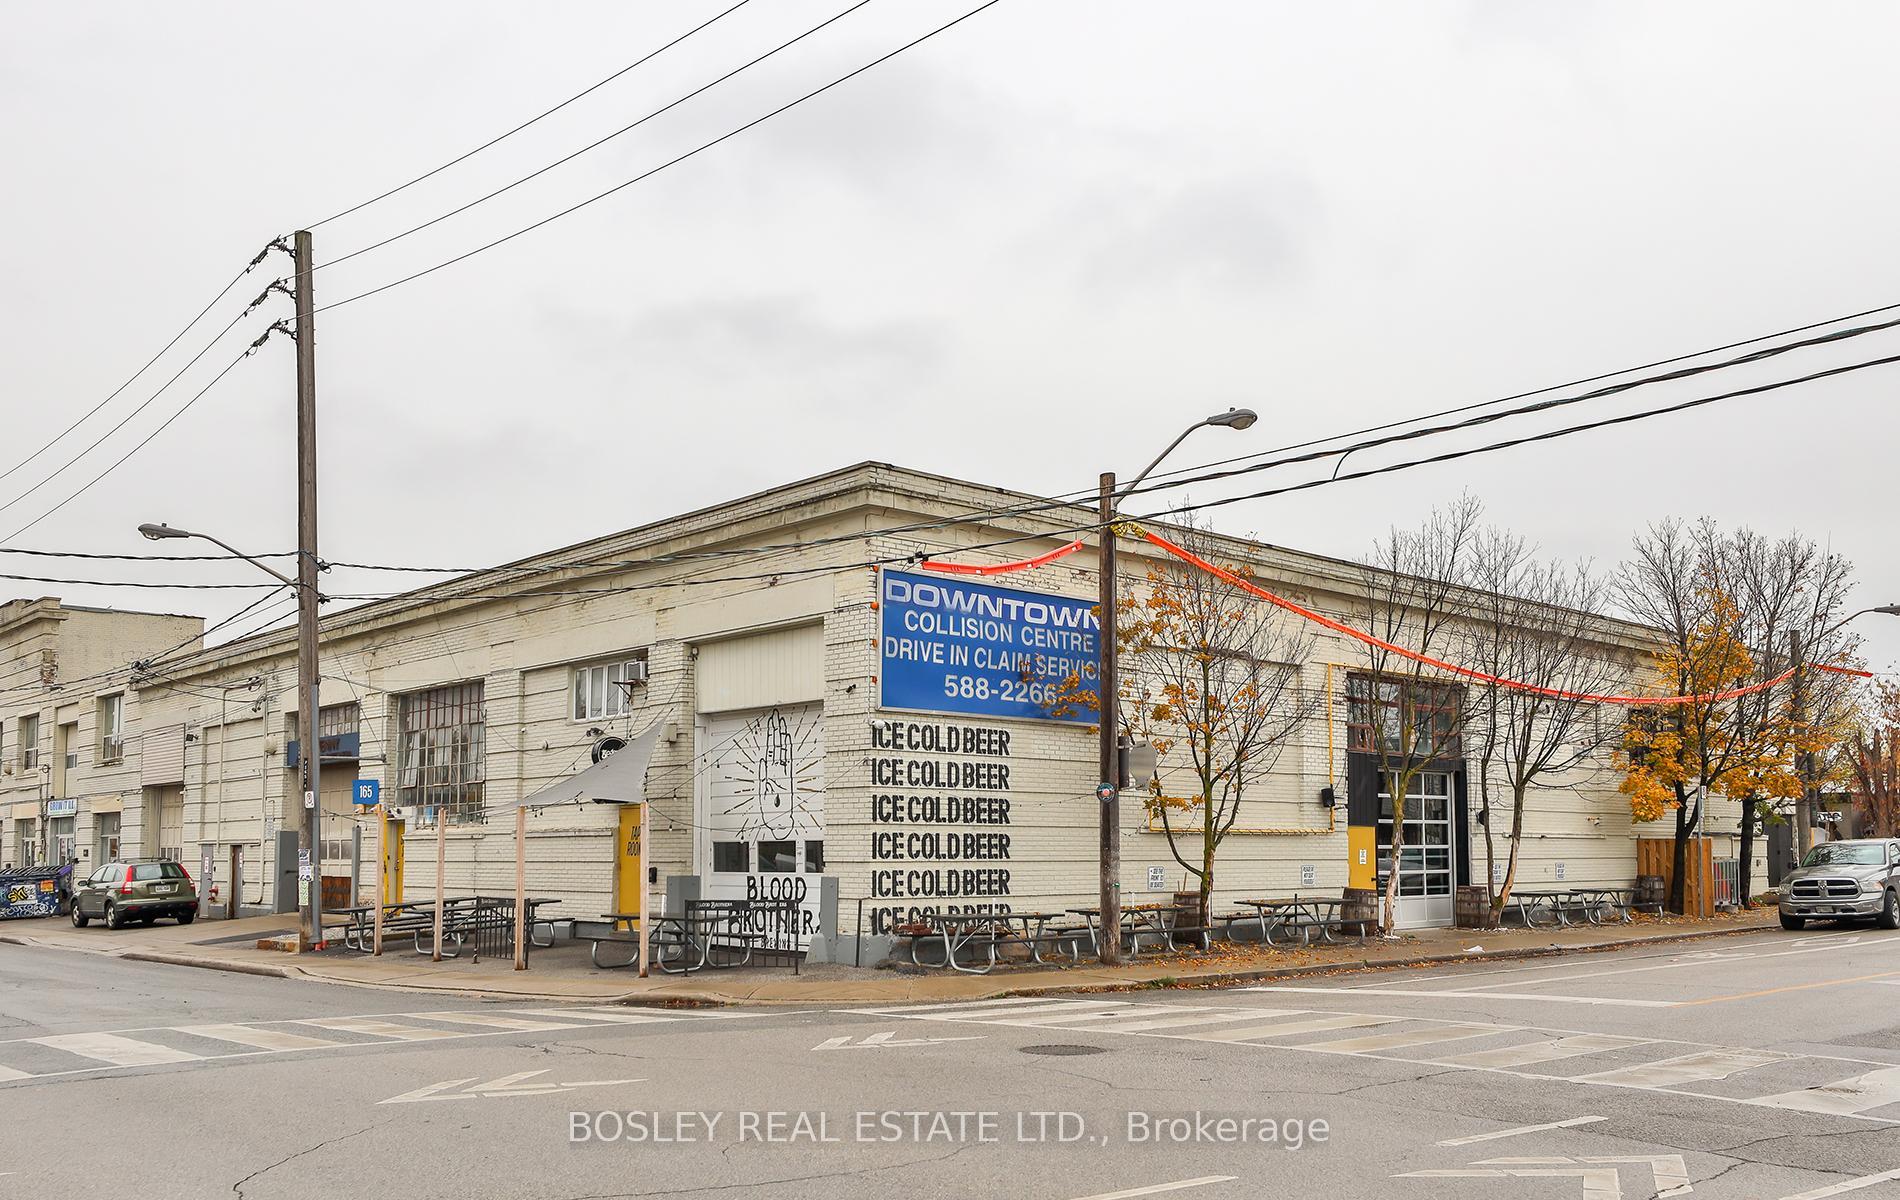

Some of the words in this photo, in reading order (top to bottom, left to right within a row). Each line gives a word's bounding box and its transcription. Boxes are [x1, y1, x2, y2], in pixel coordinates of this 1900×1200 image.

[886, 578, 1100, 630] DOWNTOWN
[904, 609, 1013, 643] COLLISION
[1020, 626, 1094, 653] CENTRE
[885, 636, 945, 664] DRIVE
[950, 644, 969, 666] IN
[974, 647, 1030, 672] CLAIM
[1035, 654, 1100, 680] SERVIC
[944, 674, 1057, 706] 588-2266
[872, 722, 904, 749] ICE
[907, 723, 960, 752] COLD
[962, 727, 1010, 755] BEER
[872, 758, 904, 785] ICE
[907, 760, 960, 787] COLD
[962, 762, 1010, 789] BEER
[360, 785, 373, 798] 165
[872, 794, 904, 822] ICE
[907, 796, 960, 823] COLD
[962, 797, 1010, 824] BEER
[872, 832, 904, 859] ICE
[907, 832, 960, 859] COLD
[962, 833, 1010, 859] BEER
[747, 876, 807, 903] BLOOD
[872, 870, 904, 897] ICE
[907, 869, 960, 896] COLD
[962, 869, 1010, 895] BEER
